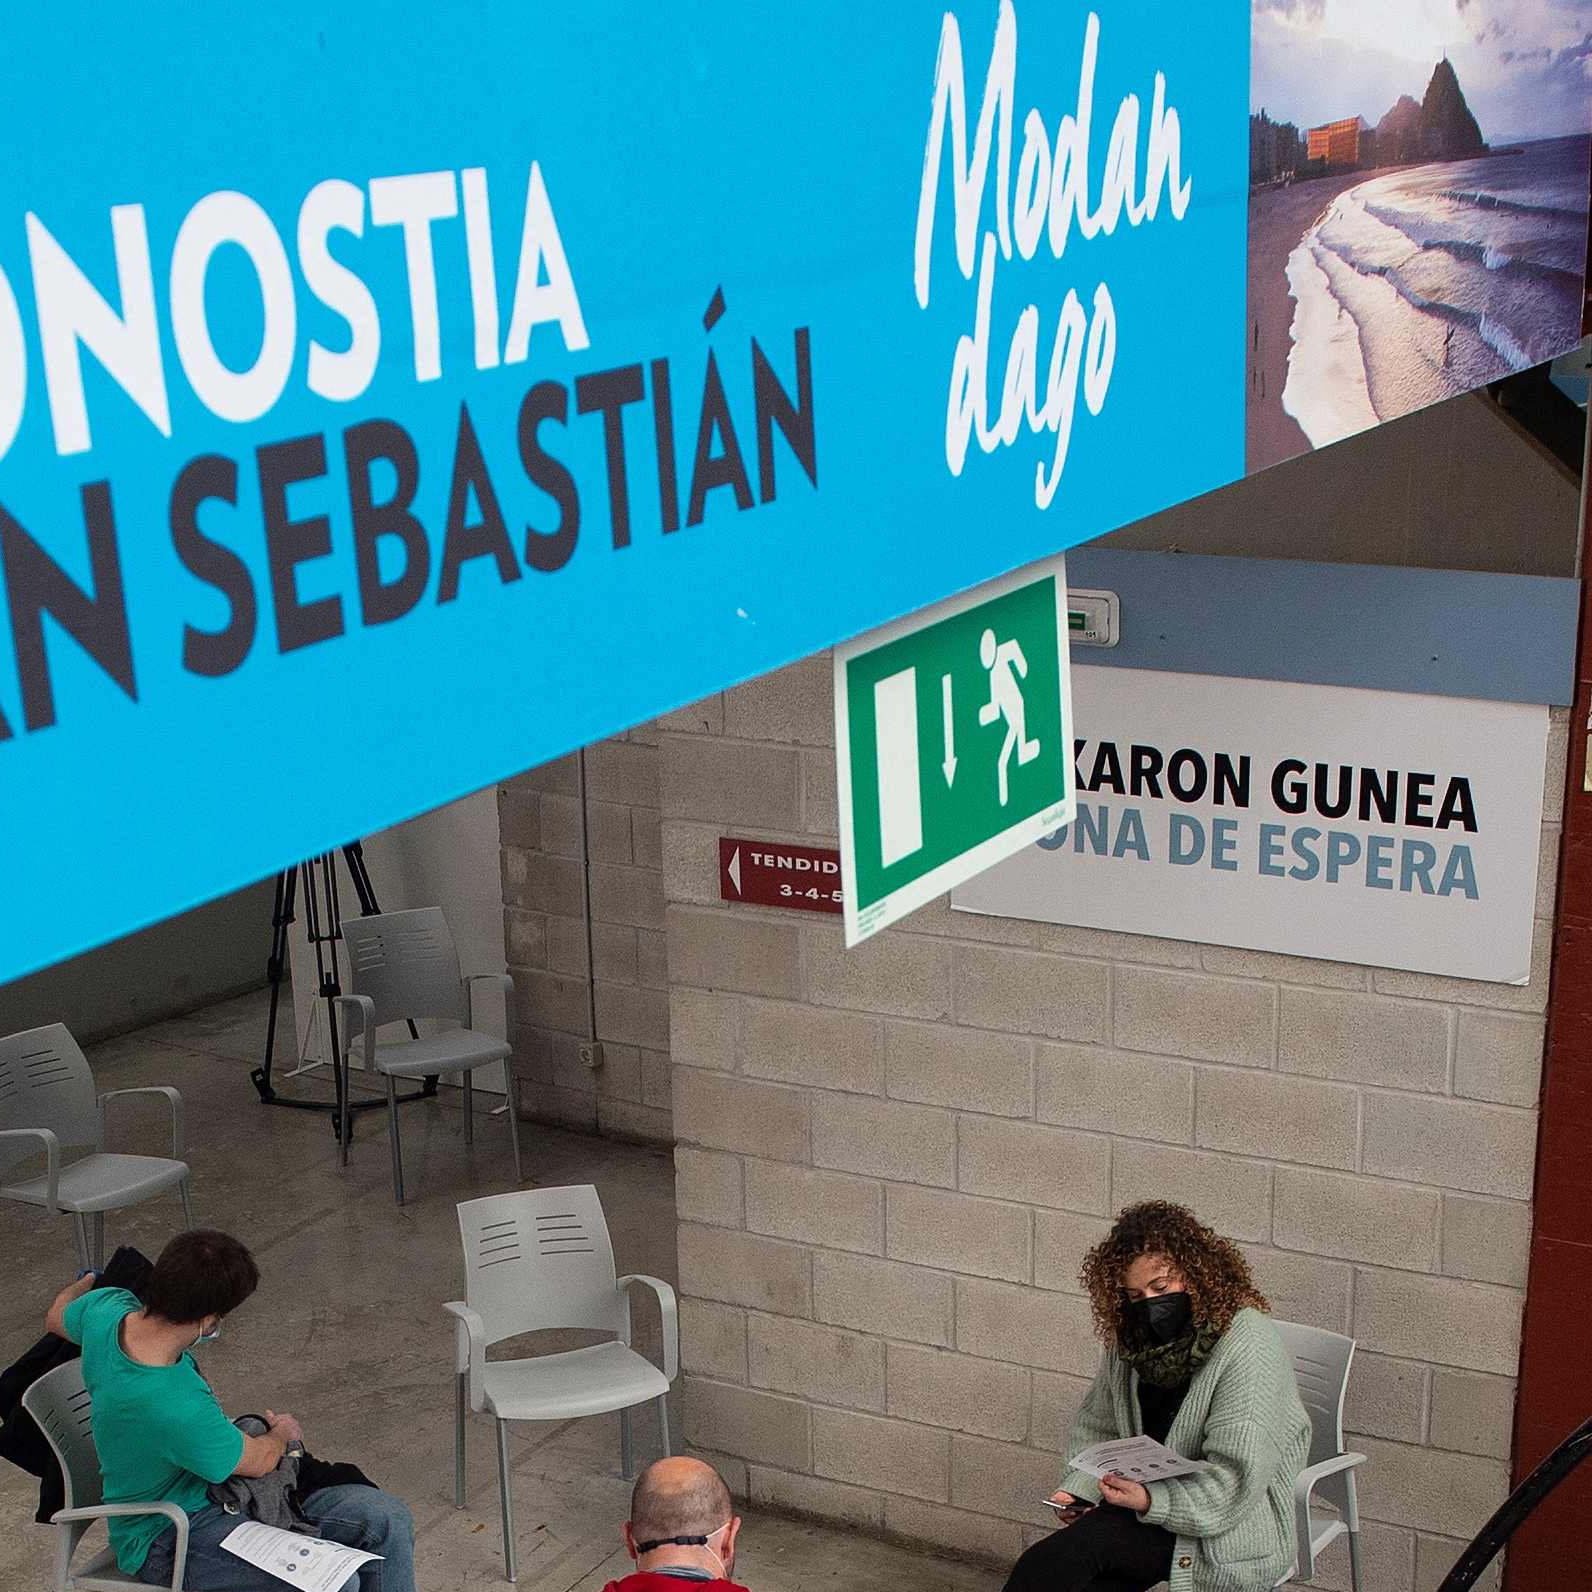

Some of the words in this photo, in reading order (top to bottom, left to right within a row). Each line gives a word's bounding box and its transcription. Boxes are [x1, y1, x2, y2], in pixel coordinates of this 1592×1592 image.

[914, 0, 1192, 310] Modan
[944, 232, 1117, 510] dago
[169, 284, 819, 680] SEBASTIÁN
[750, 852, 841, 875] TENDID
[1168, 812, 1239, 872] DE
[1257, 822, 1480, 901] ESPERA
[1270, 758, 1479, 834] GUNEA
